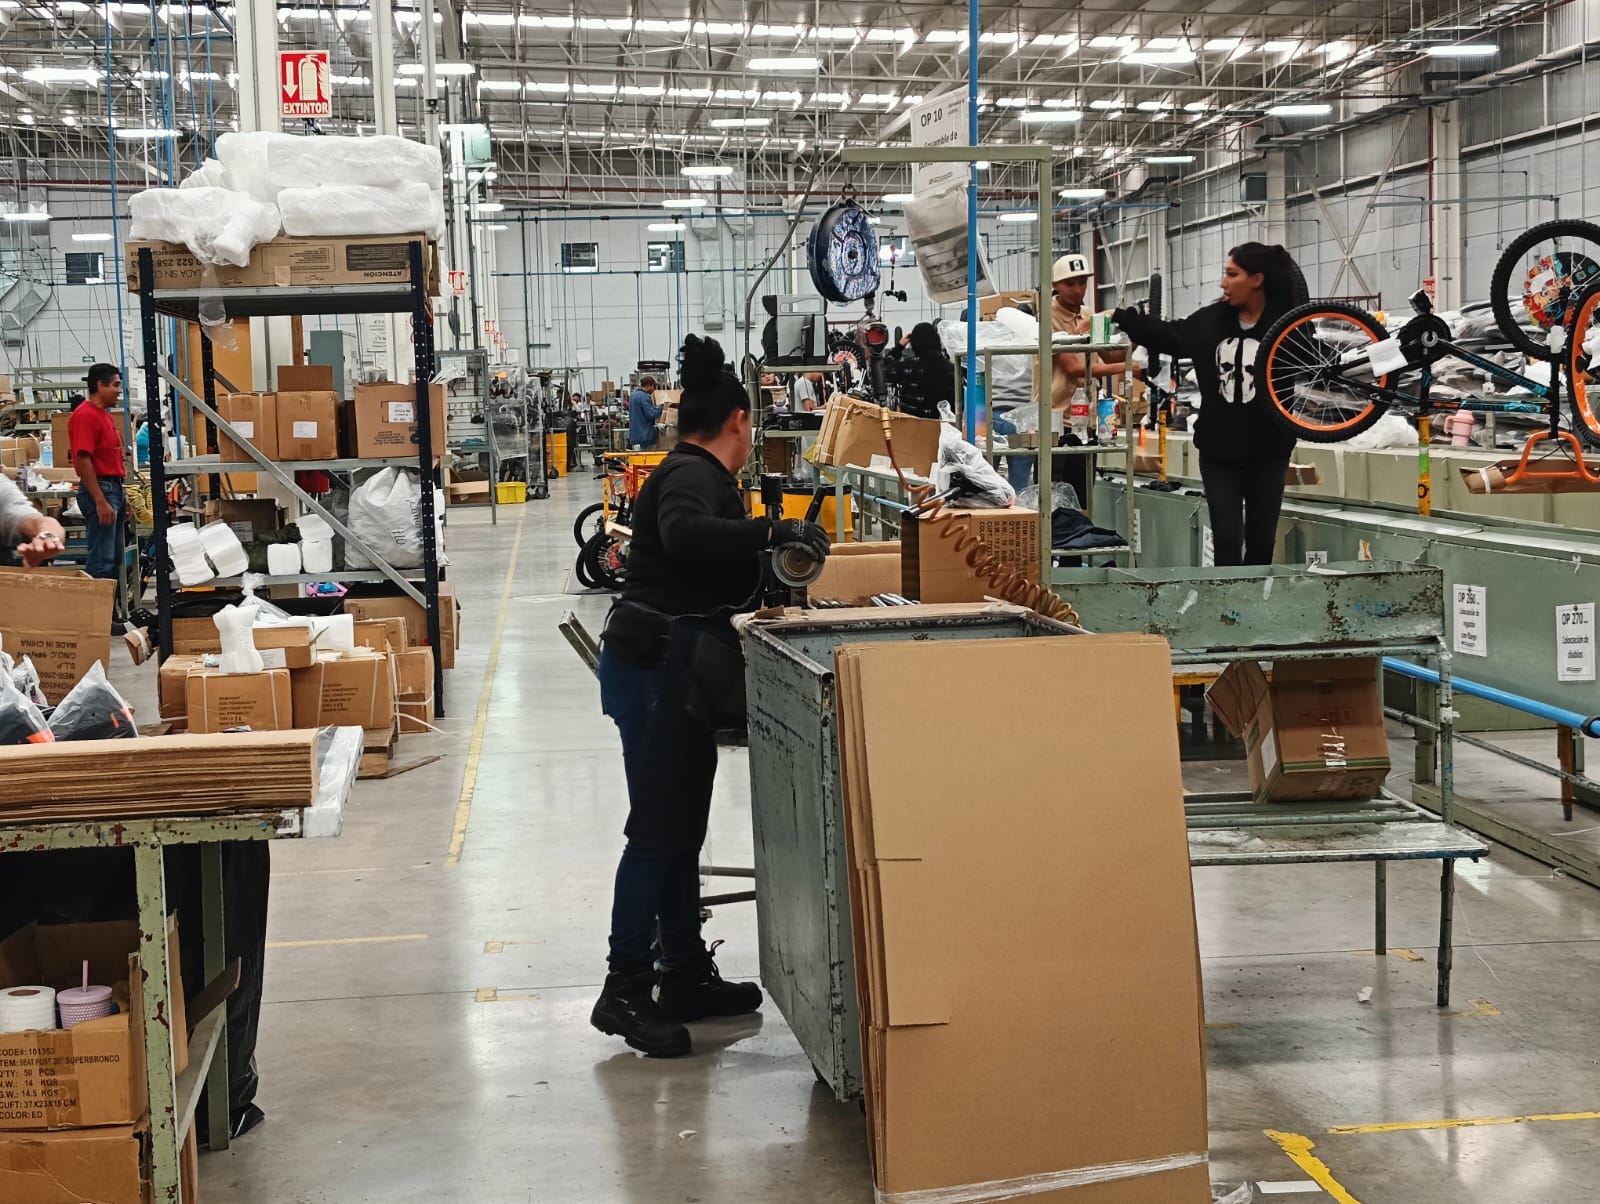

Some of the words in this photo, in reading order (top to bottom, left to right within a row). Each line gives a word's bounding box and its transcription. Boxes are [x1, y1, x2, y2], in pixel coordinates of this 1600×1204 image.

[283, 102, 329, 114] EXTINTOR
[921, 112, 931, 127] OP
[933, 107, 943, 123] 10
[164, 270, 178, 279] SIN
[180, 270, 201, 279] LADA
[363, 270, 402, 278] ATENCIÓN
[1562, 613, 1570, 625] OP
[1572, 612, 1583, 624] 270
[20, 640, 45, 648] CHINA
[55, 641, 77, 649] MADE
[0, 1048, 27, 1057] ODE#:
[0, 1059, 18, 1067] TEM:
[65, 1055, 120, 1065] SUPERBRONCO
[23, 1068, 33, 1077] 50
[39, 1067, 56, 1077] PCS
[25, 1079, 33, 1087] 14
[40, 1078, 58, 1087] KGS
[41, 1088, 59, 1097] KGS
[0, 1101, 22, 1109] CUFT:
[63, 1099, 77, 1107] CM
[0, 1111, 30, 1119] COLOR:
[31, 1111, 43, 1119] ED
